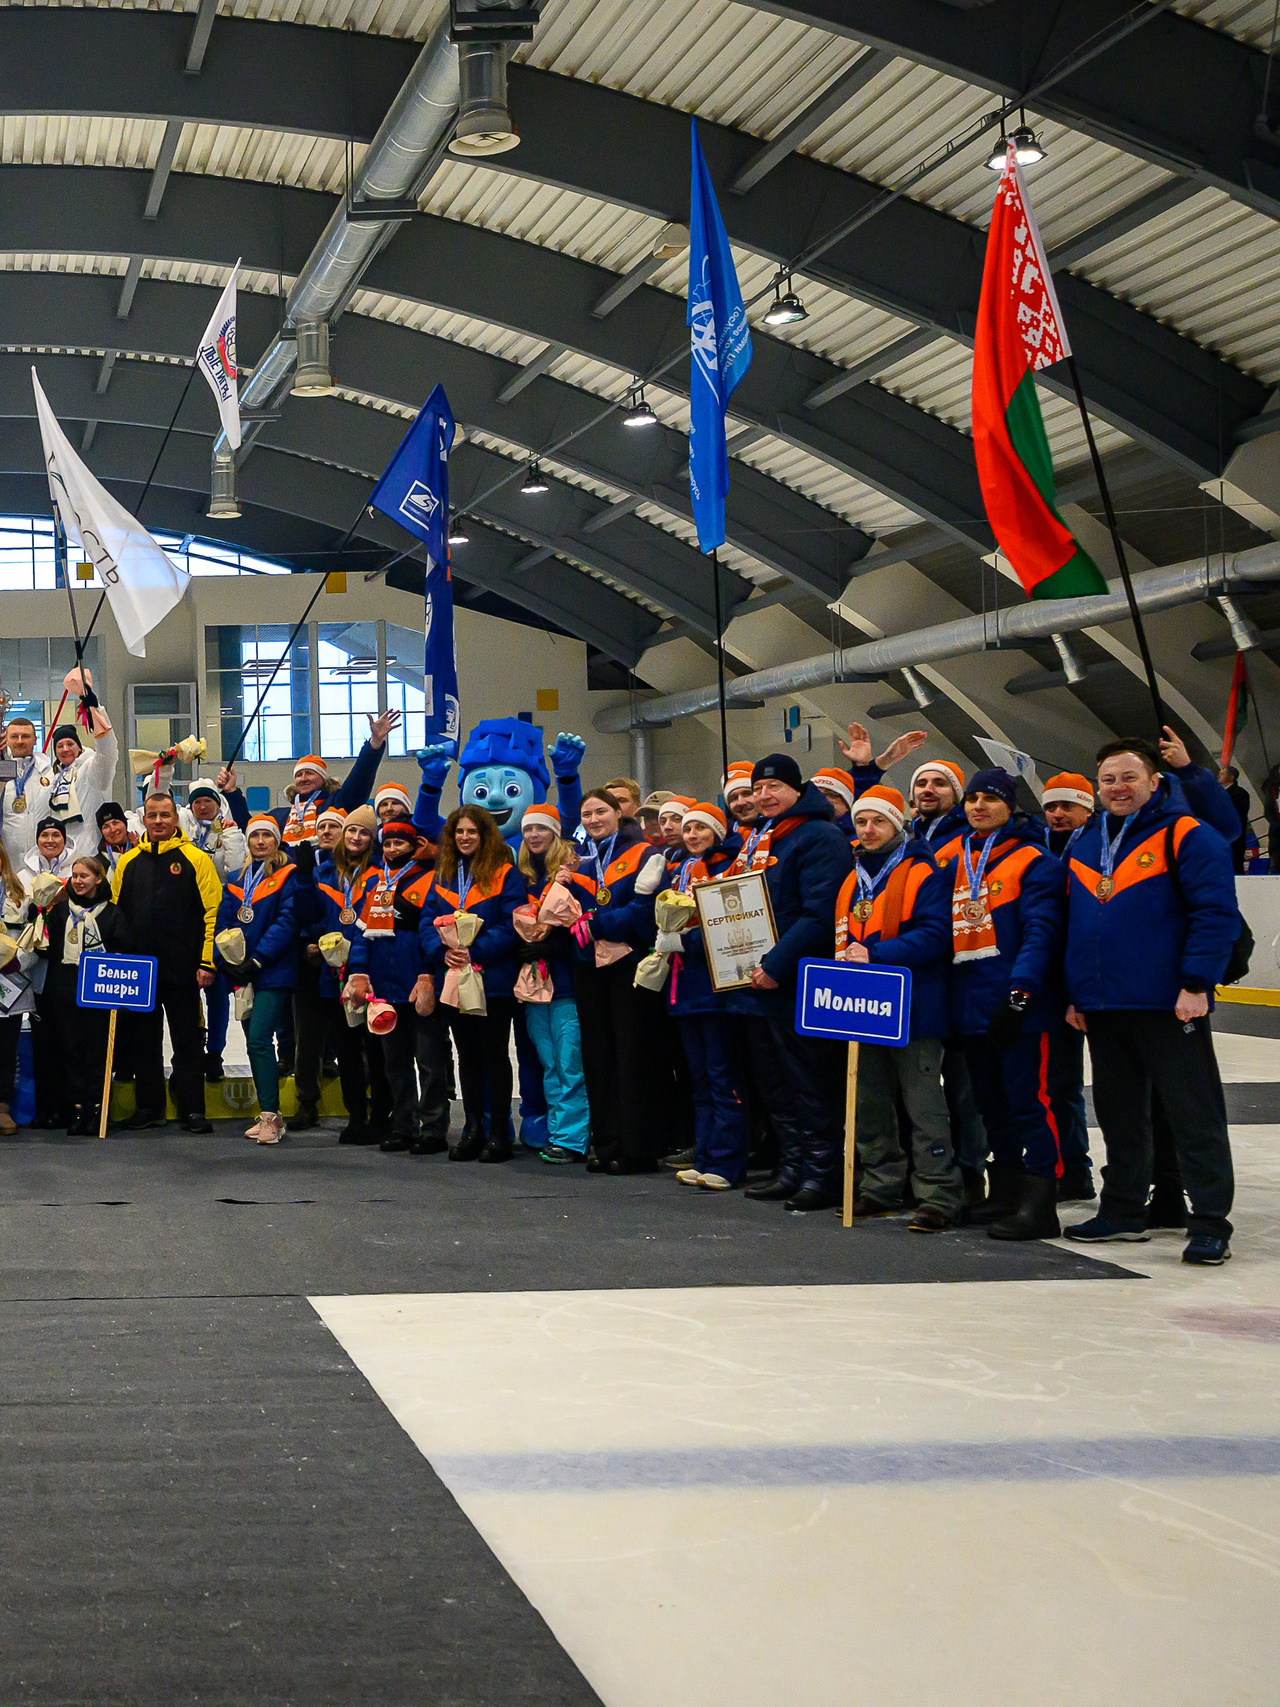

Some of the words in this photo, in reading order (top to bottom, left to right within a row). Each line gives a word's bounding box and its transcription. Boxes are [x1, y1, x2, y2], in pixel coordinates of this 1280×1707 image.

[707, 908, 765, 927] СЕРТИФИКАТ
[97, 963, 139, 980] Белые
[94, 982, 139, 999] тигры
[813, 987, 892, 1017] Молния
